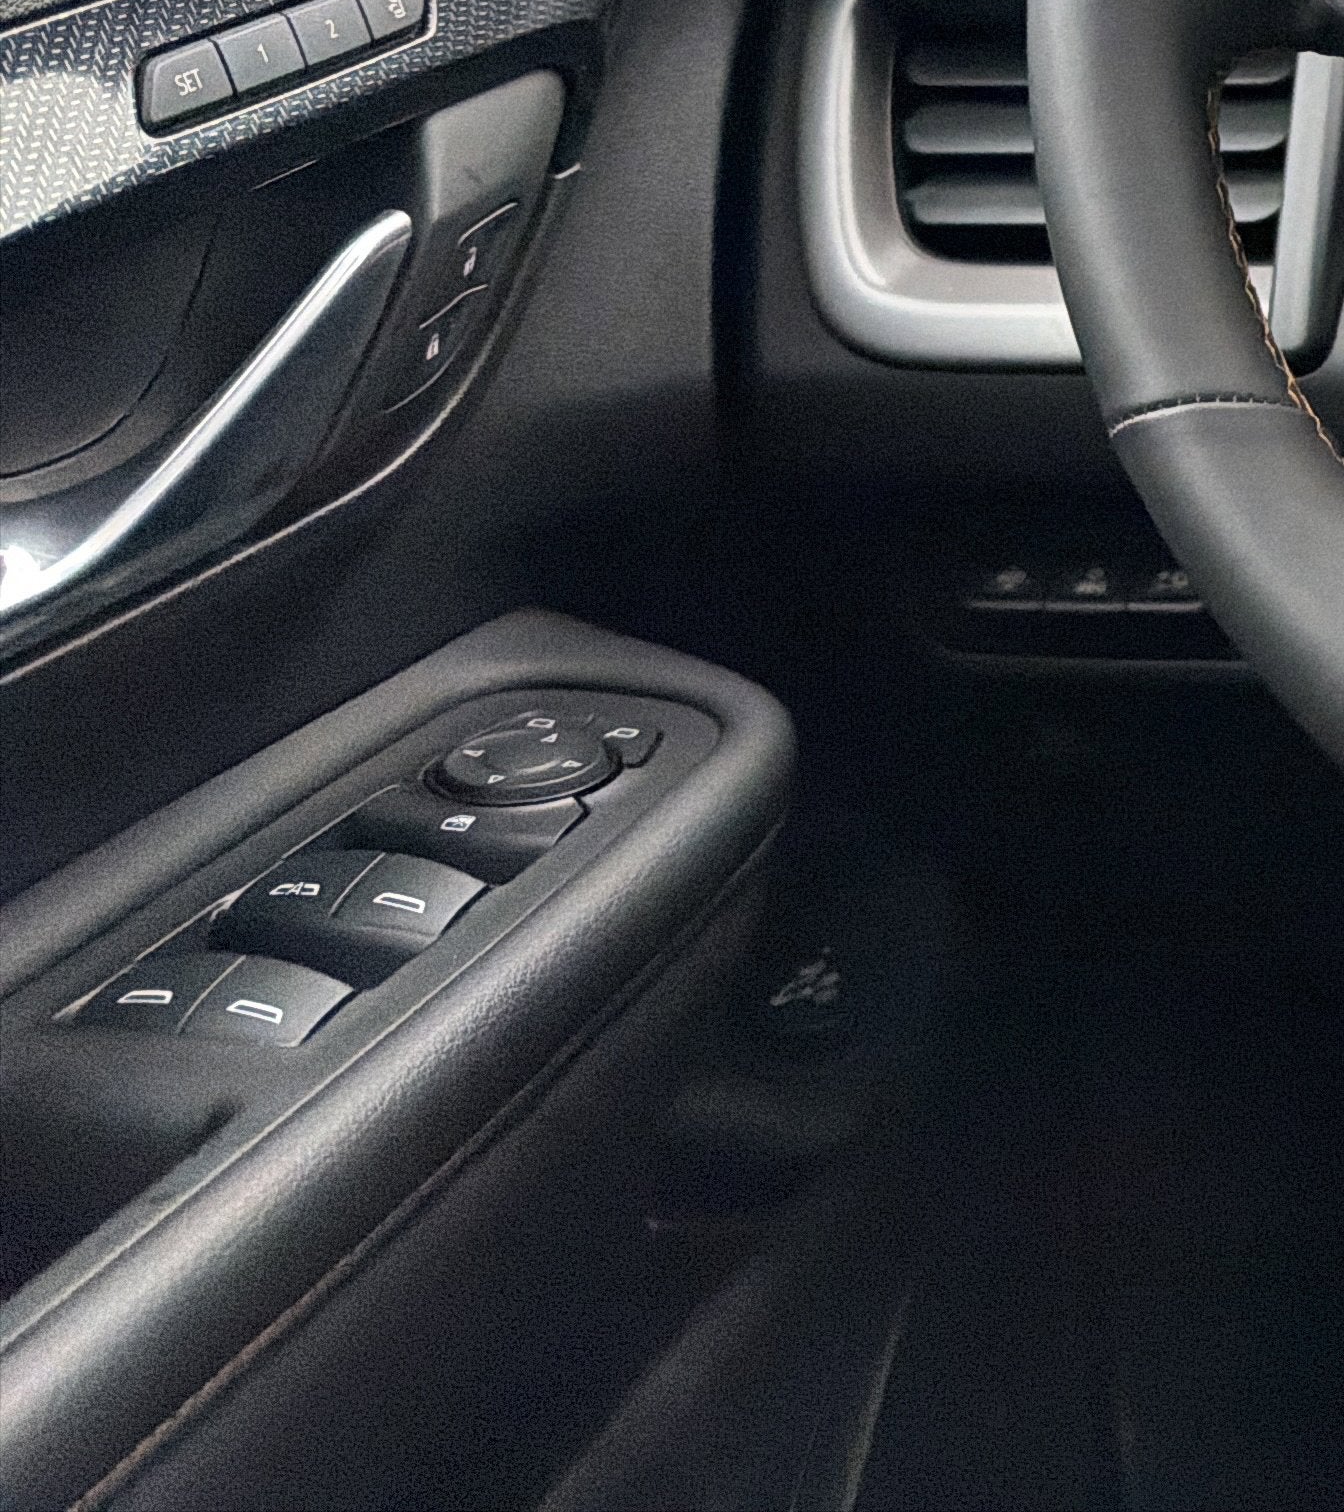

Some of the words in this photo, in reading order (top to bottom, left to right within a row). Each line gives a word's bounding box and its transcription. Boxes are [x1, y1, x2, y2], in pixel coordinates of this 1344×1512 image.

[325, 18, 338, 39] 2
[256, 42, 269, 65] 1
[174, 68, 203, 97] SET
